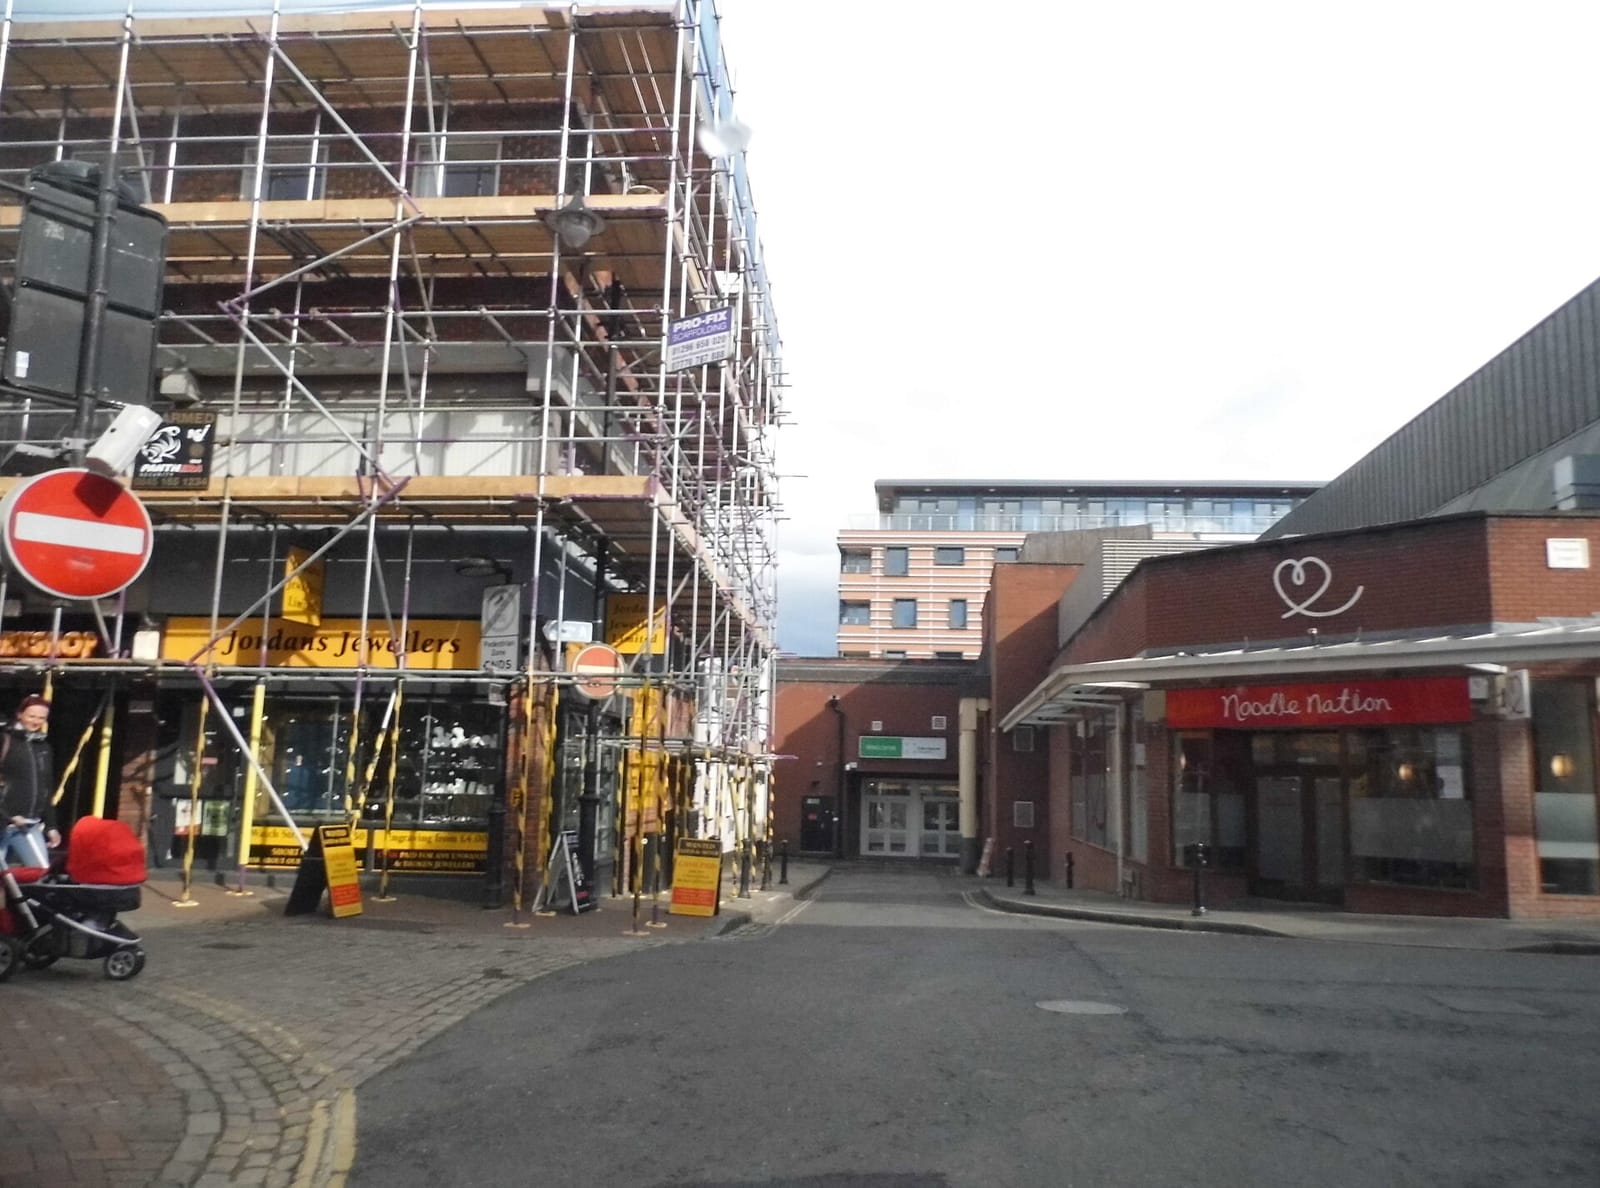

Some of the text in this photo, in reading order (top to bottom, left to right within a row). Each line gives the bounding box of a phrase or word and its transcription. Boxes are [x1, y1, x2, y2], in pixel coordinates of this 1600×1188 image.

[672, 322, 728, 342] SCAFFOLDING
[673, 310, 728, 333] PRO-FIX
[221, 629, 328, 656] Jordans
[1221, 692, 1301, 721] Noodle
